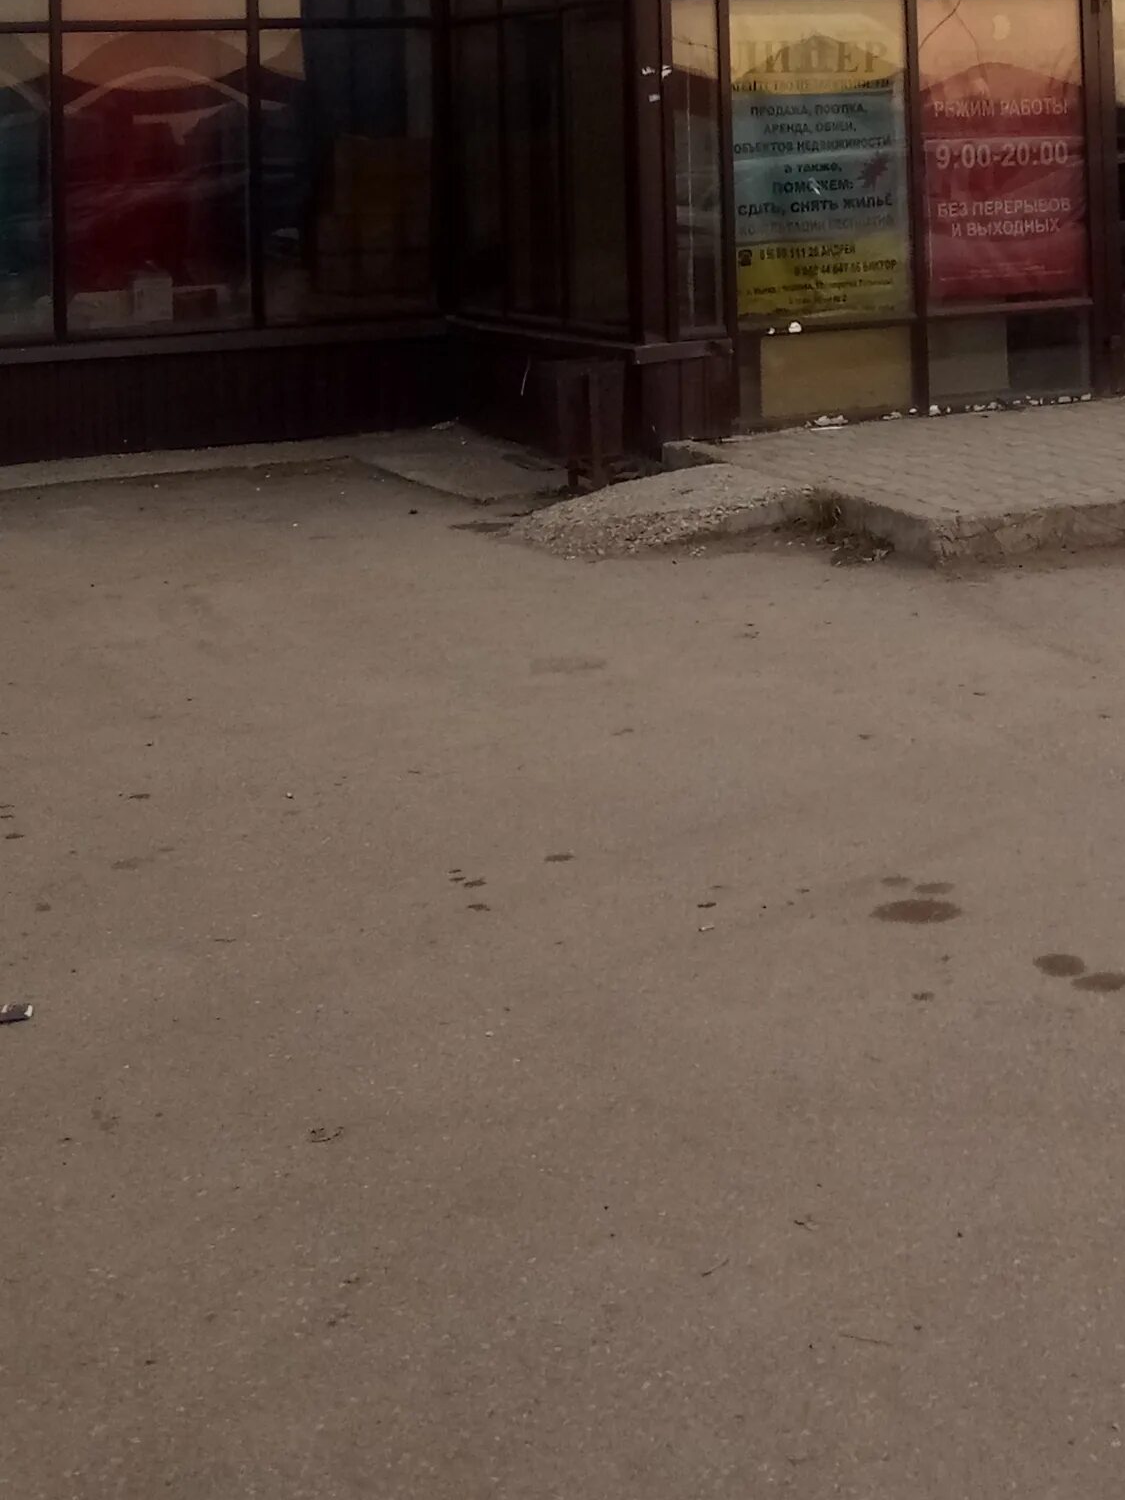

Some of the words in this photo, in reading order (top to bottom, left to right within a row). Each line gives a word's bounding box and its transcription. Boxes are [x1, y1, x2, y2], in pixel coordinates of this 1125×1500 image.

[933, 100, 995, 117] РЕЖИМ
[1000, 96, 1069, 116] РАБОТЫ
[935, 139, 1070, 170] 9:00-20:00
[790, 199, 840, 214] СНЯТЬ
[937, 201, 969, 218] БЕЗ
[972, 196, 1072, 216] ПЕРЕРЫВОВ
[952, 222, 962, 239] И
[967, 216, 1061, 238] ВЫХОДНЫХ
